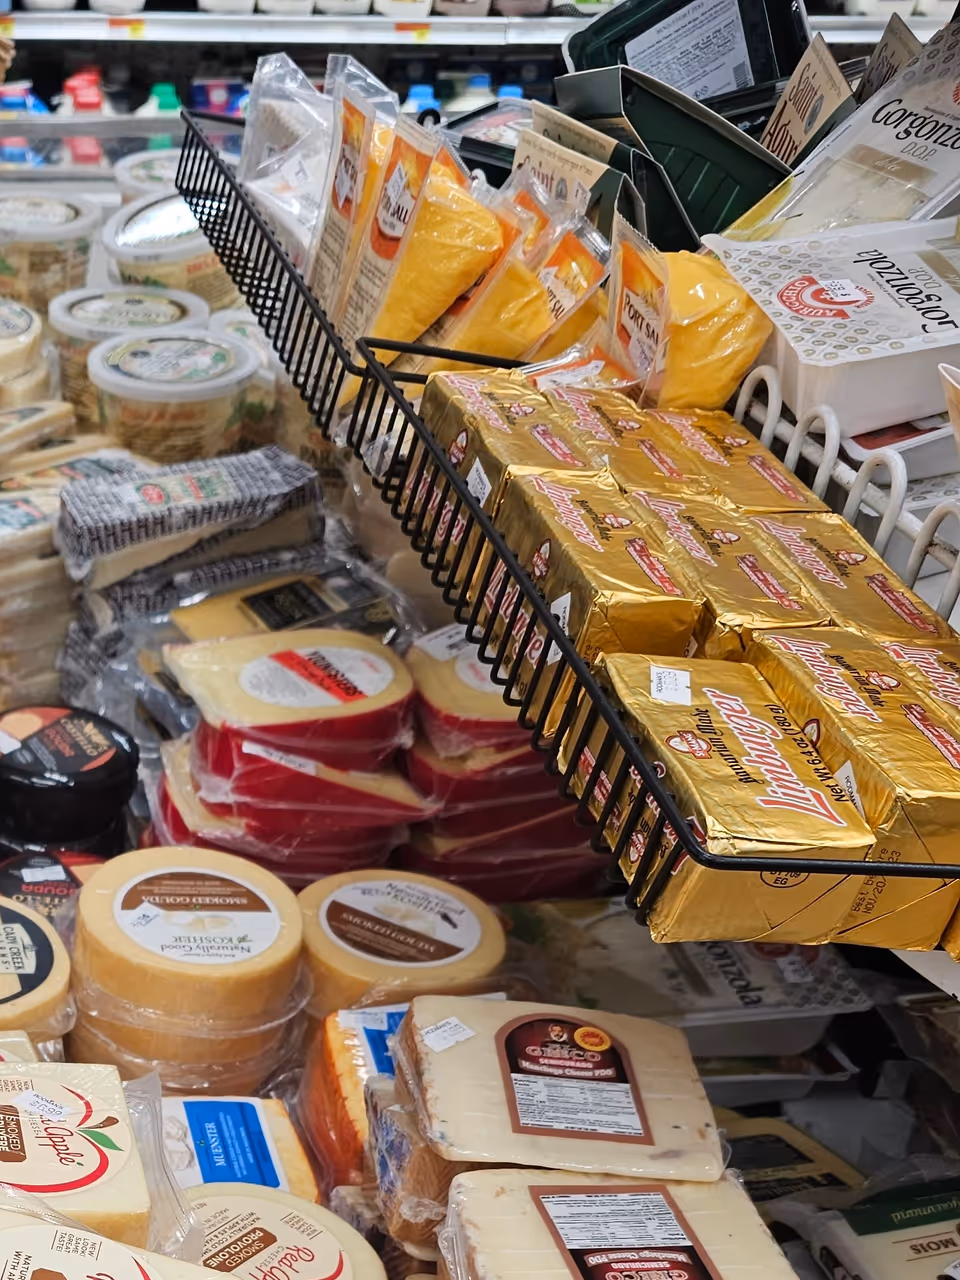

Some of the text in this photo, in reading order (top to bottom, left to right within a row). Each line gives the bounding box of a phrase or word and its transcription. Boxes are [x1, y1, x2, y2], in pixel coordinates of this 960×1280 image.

[789, 63, 821, 122] Saint
[624, 291, 645, 332] PORT
[530, 474, 604, 553] Limburger
[631, 490, 719, 568] Limburger
[749, 516, 848, 590] Limburger
[765, 634, 883, 723] Limburger
[691, 707, 766, 785] Bavarian Made
[702, 687, 847, 827] Limburger
[775, 716, 849, 803] Net Wt 6.4 oz (180
[141, 896, 248, 905] SMOKED GOUDA
[773, 877, 788, 886] EG
[9, 945, 25, 971] CREEK
[160, 943, 252, 954] Naturally Good
[171, 935, 233, 944] KOSHER
[35, 1125, 76, 1166] Apple
[205, 1121, 226, 1167] MUENSTER
[12, 1250, 22, 1270] WITH
[206, 1230, 264, 1268] PROVOLONE
[226, 1241, 265, 1267] SMOKED
[588, 1254, 606, 1264] PDO
[910, 1238, 958, 1254] MOIS
